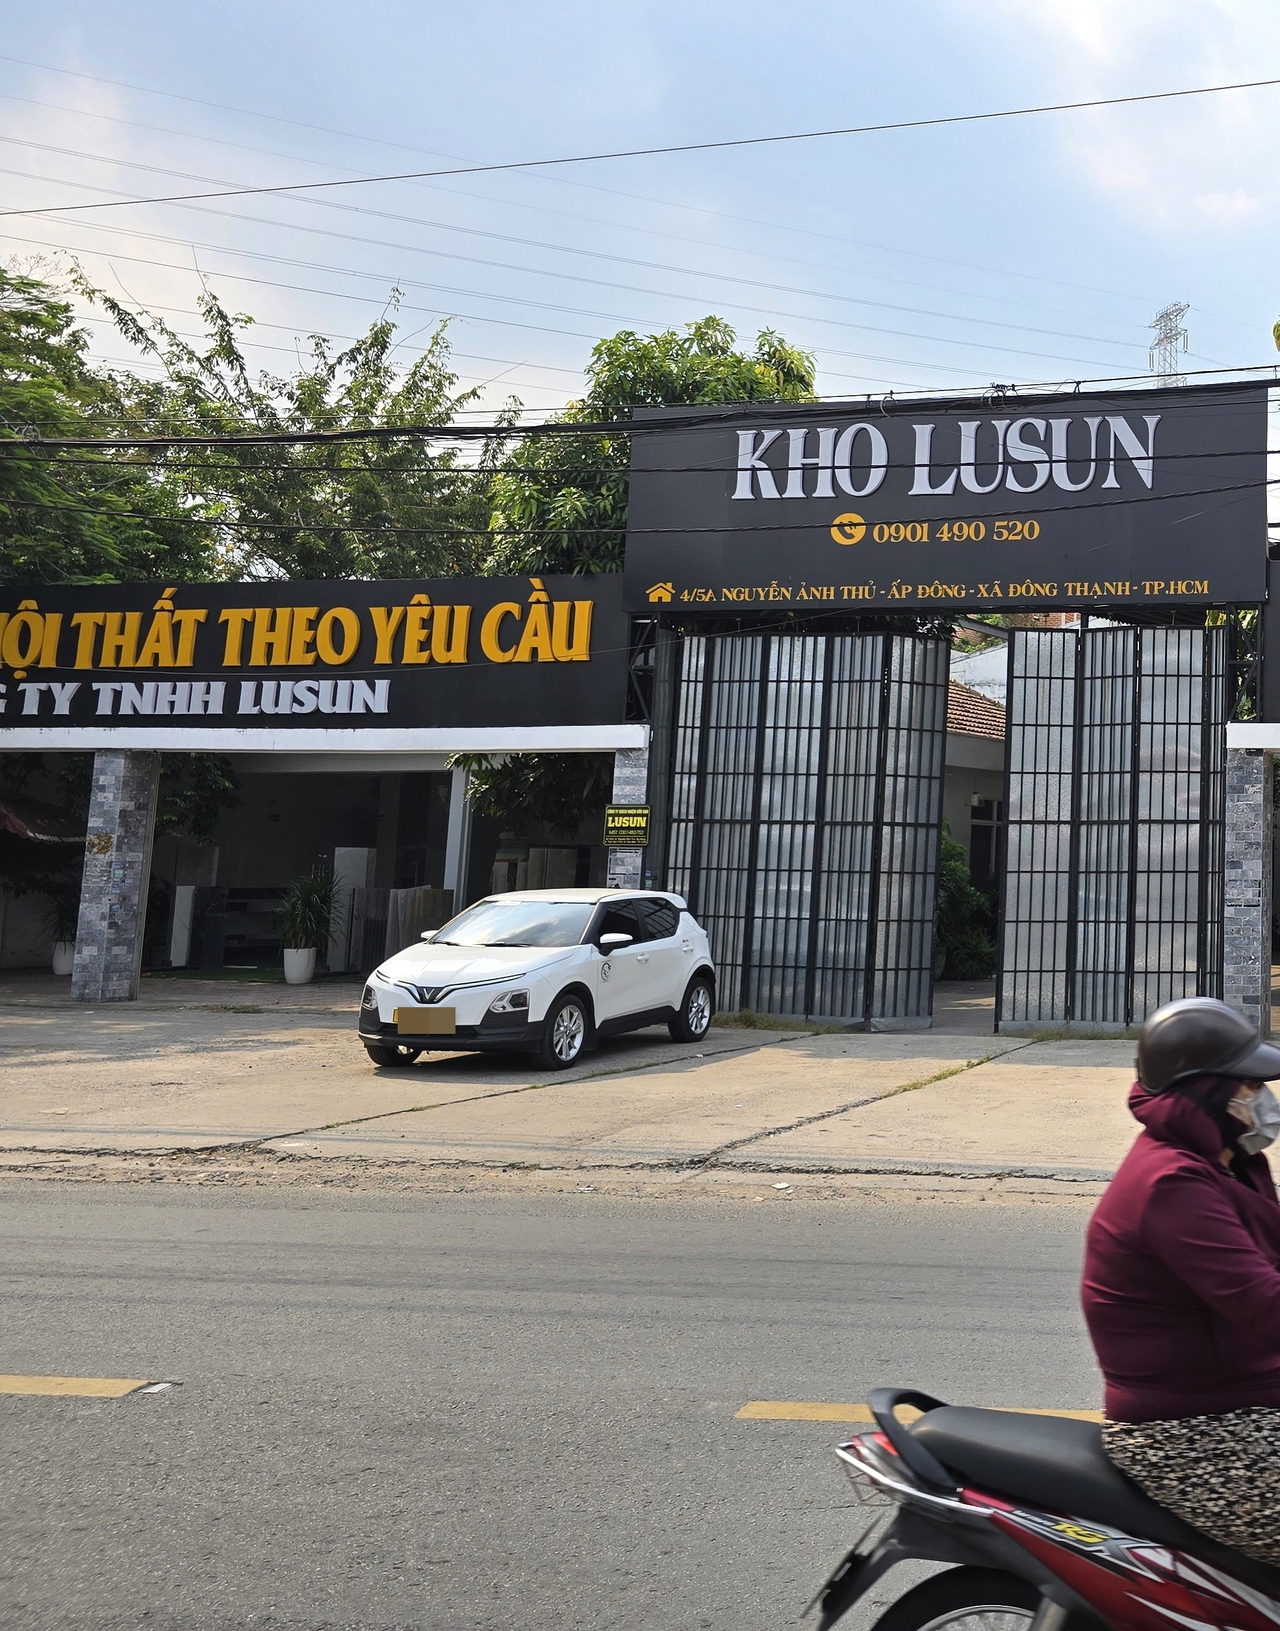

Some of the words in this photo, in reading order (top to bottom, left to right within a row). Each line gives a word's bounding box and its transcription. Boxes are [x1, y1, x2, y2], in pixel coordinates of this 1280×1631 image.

[730, 422, 888, 500] KHO
[907, 414, 1163, 496] LUSUN
[873, 523, 929, 542] 0901
[936, 521, 985, 541] 490
[993, 519, 1040, 540] 520
[680, 588, 717, 602] 4/5A
[721, 580, 792, 602] NGUYỄN
[796, 581, 835, 600] ẢNH
[840, 579, 877, 600] THỦ
[887, 579, 913, 599] ẤP
[916, 580, 966, 598] ĐÔNG
[977, 580, 1003, 598] XÃ
[1008, 579, 1059, 598] ĐÔNG
[1064, 581, 1130, 599] THẠNH
[1142, 580, 1209, 595] TP.HCM
[0, 599, 63, 679] ỘI
[70, 587, 208, 670] THẤT
[218, 606, 361, 667] THEO
[368, 593, 472, 665] YÊU
[480, 577, 594, 663] CẦU
[17, 682, 82, 715] TY
[91, 681, 227, 715] TNHH
[236, 679, 391, 715] LUSUN
[607, 816, 647, 828] LUSUN
